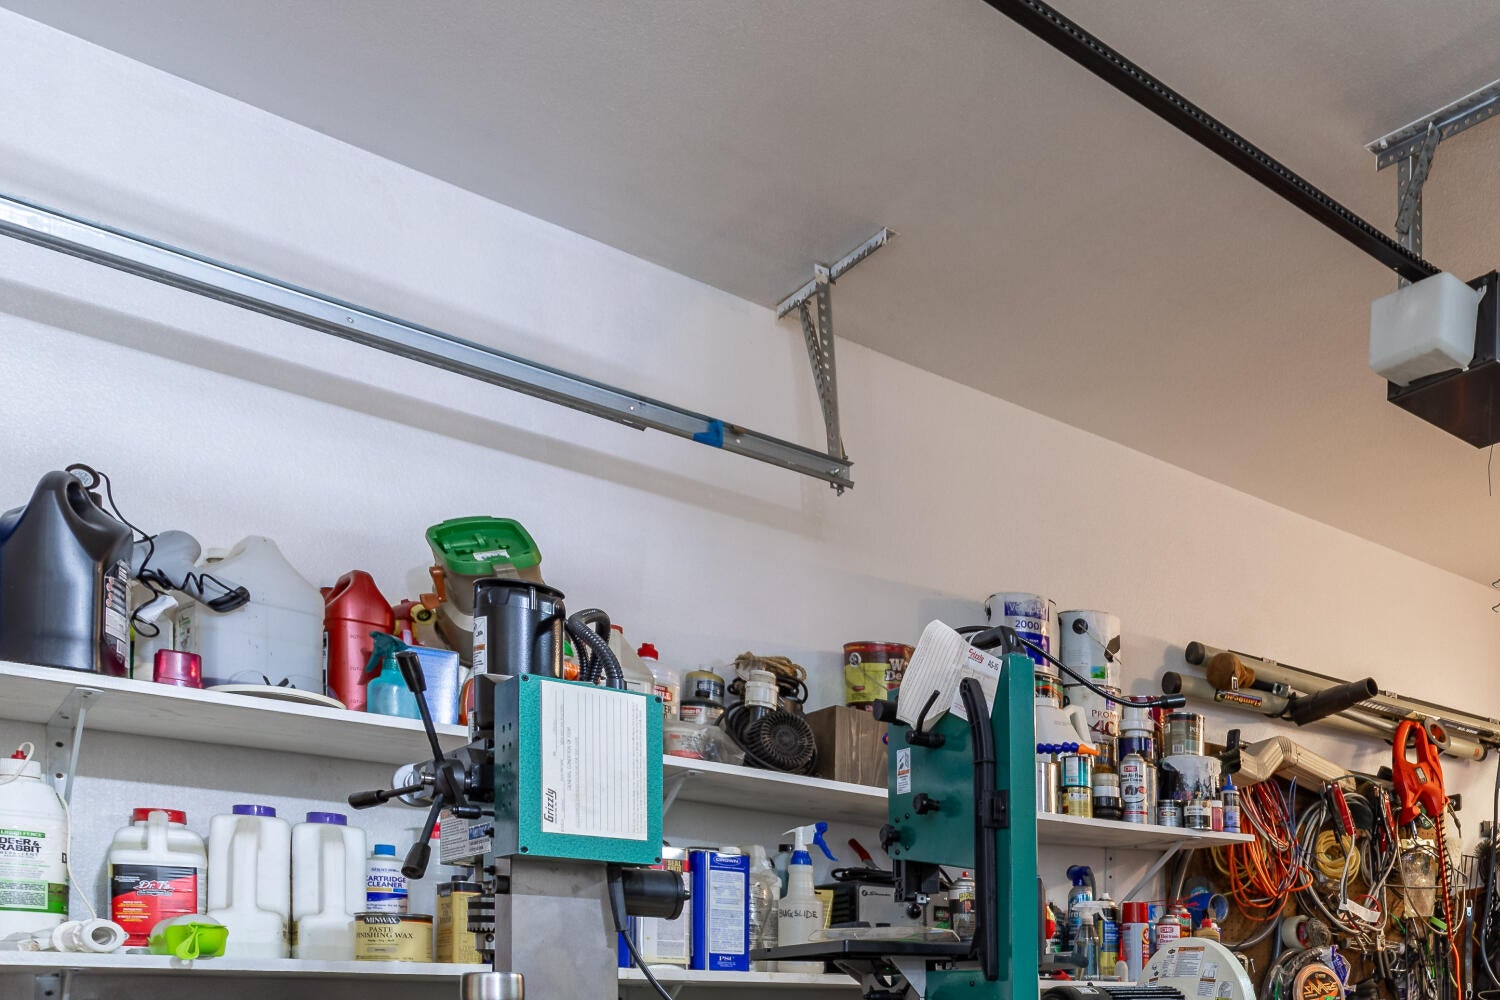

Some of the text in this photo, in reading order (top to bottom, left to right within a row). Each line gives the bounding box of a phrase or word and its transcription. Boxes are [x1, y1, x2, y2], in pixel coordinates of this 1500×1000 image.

[1016, 619, 1040, 630] 2000
[544, 787, 557, 823] Grizzly
[0, 837, 31, 846] DEER
[0, 844, 41, 853] RABBIT
[367, 881, 403, 889] CLEANER
[365, 917, 399, 925] MINWAX
